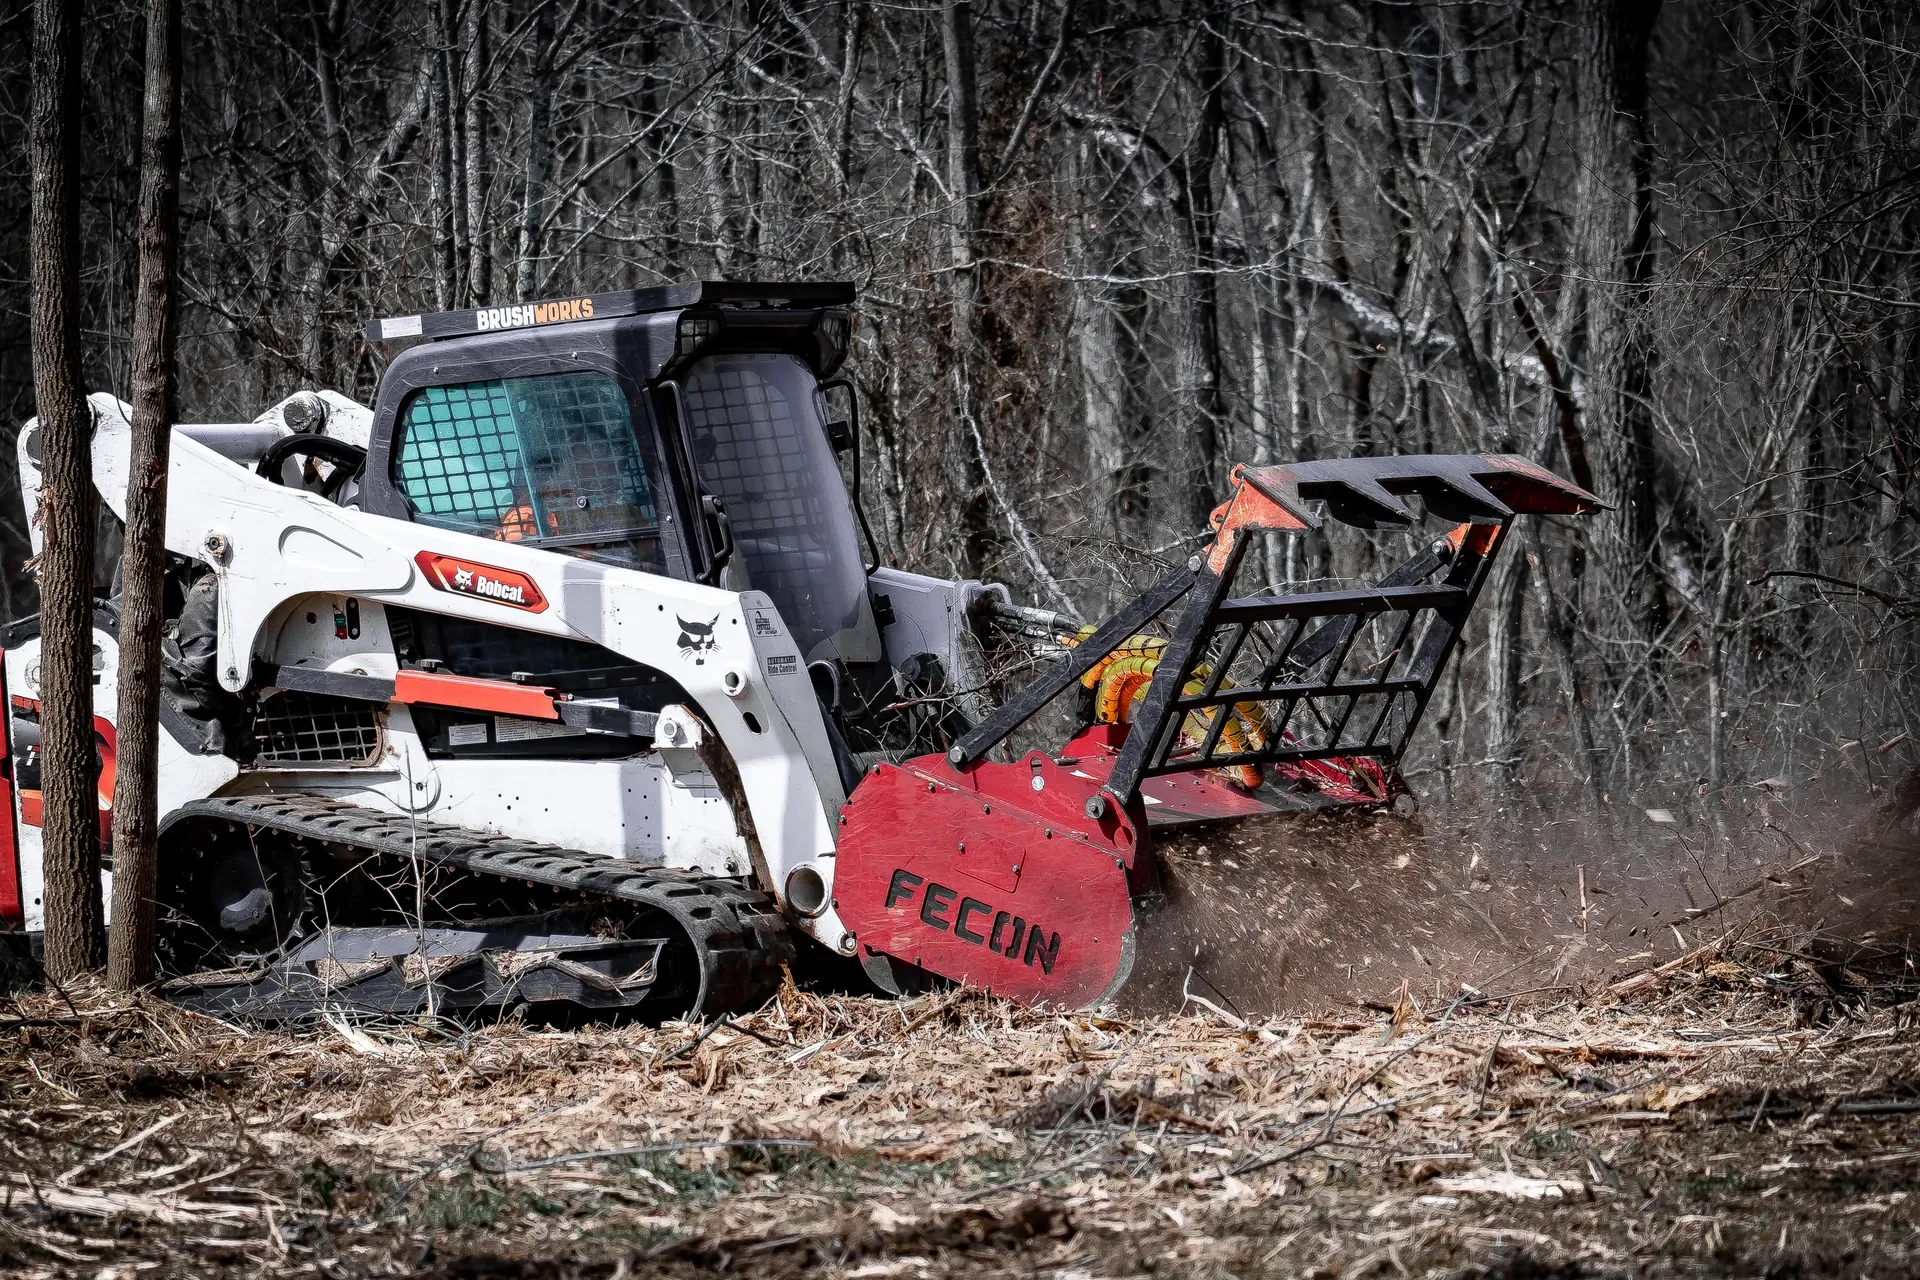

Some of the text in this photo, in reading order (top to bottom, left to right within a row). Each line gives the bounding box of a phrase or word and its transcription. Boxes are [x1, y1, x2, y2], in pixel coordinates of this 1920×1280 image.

[476, 299, 594, 330] BRUSHWORKS
[768, 664, 797, 673] Ride Control
[884, 868, 1061, 976] FECON
